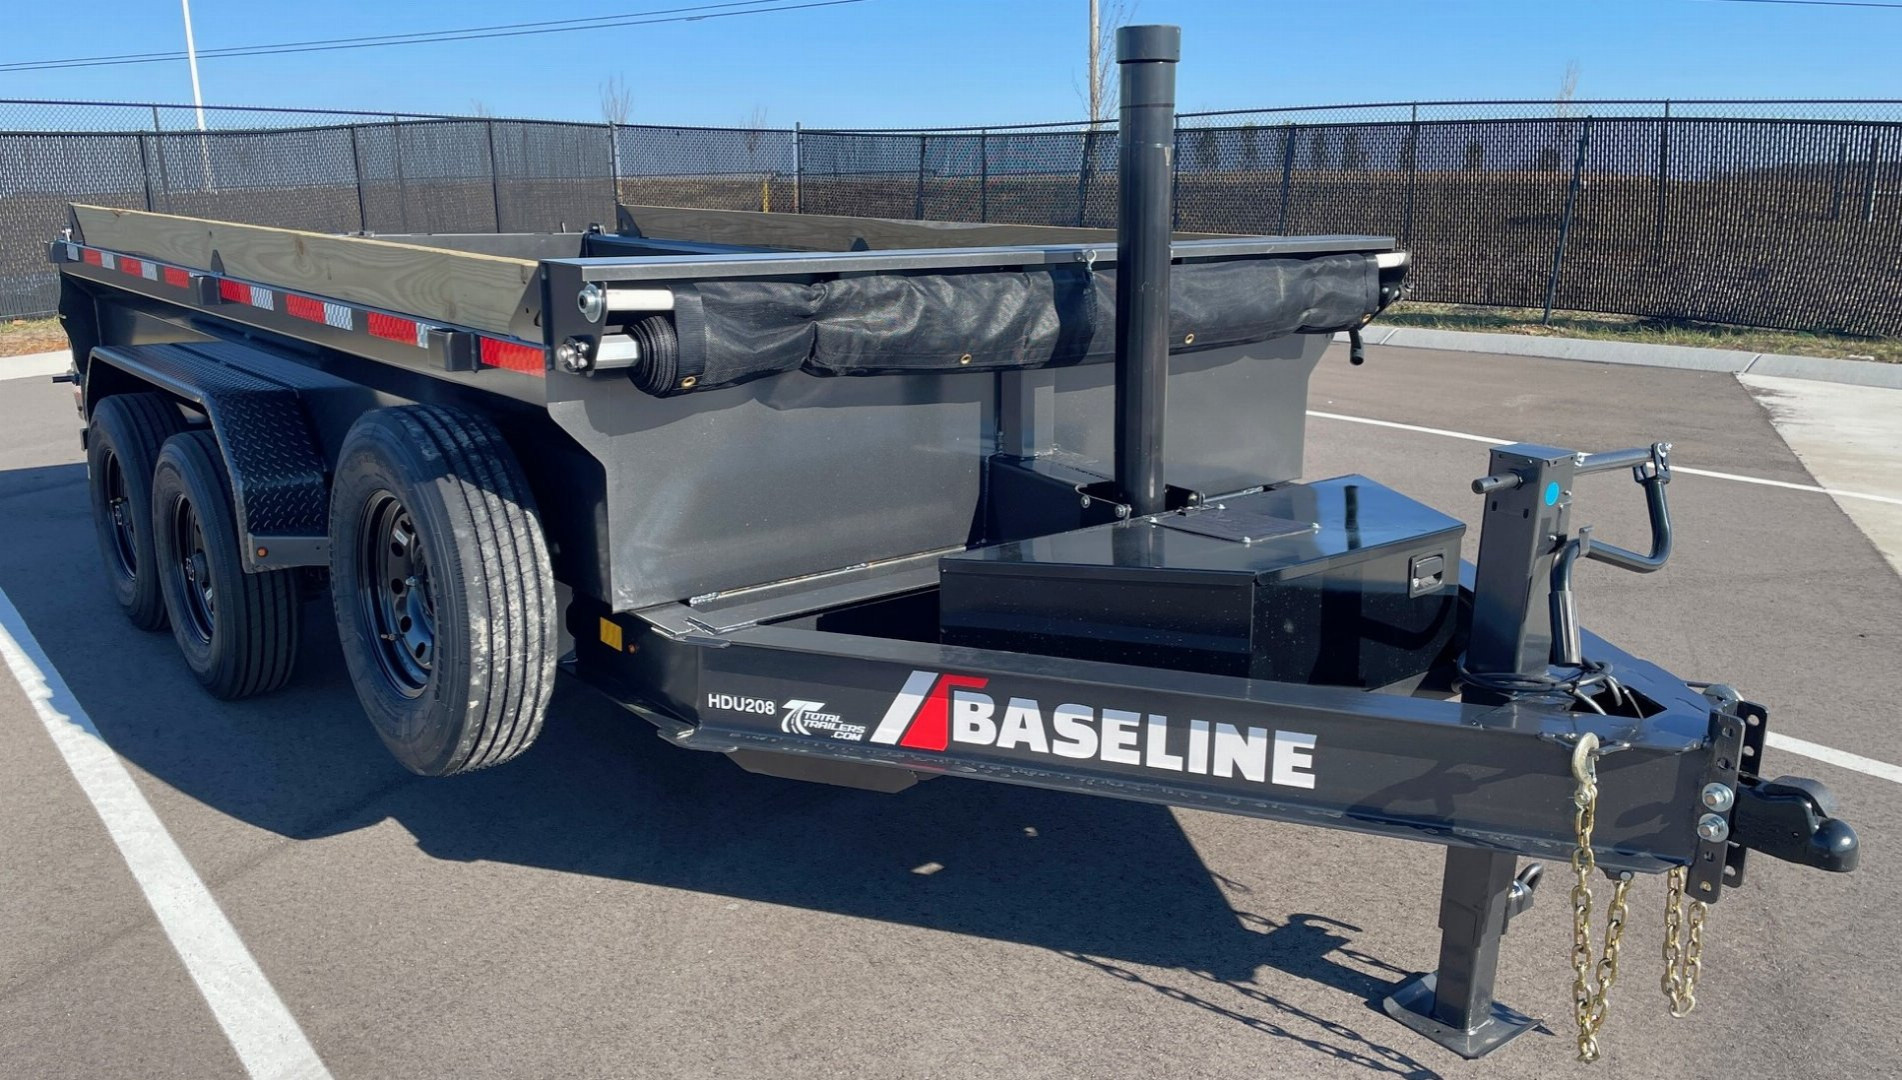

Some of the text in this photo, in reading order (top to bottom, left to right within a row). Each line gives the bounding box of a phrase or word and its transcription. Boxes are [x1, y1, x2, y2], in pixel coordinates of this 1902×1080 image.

[708, 693, 775, 715] HDU208
[804, 711, 843, 724] TOTAL
[803, 719, 866, 734] TRAILERS
[830, 731, 863, 742] .COM
[952, 689, 1317, 789] BASELINE
